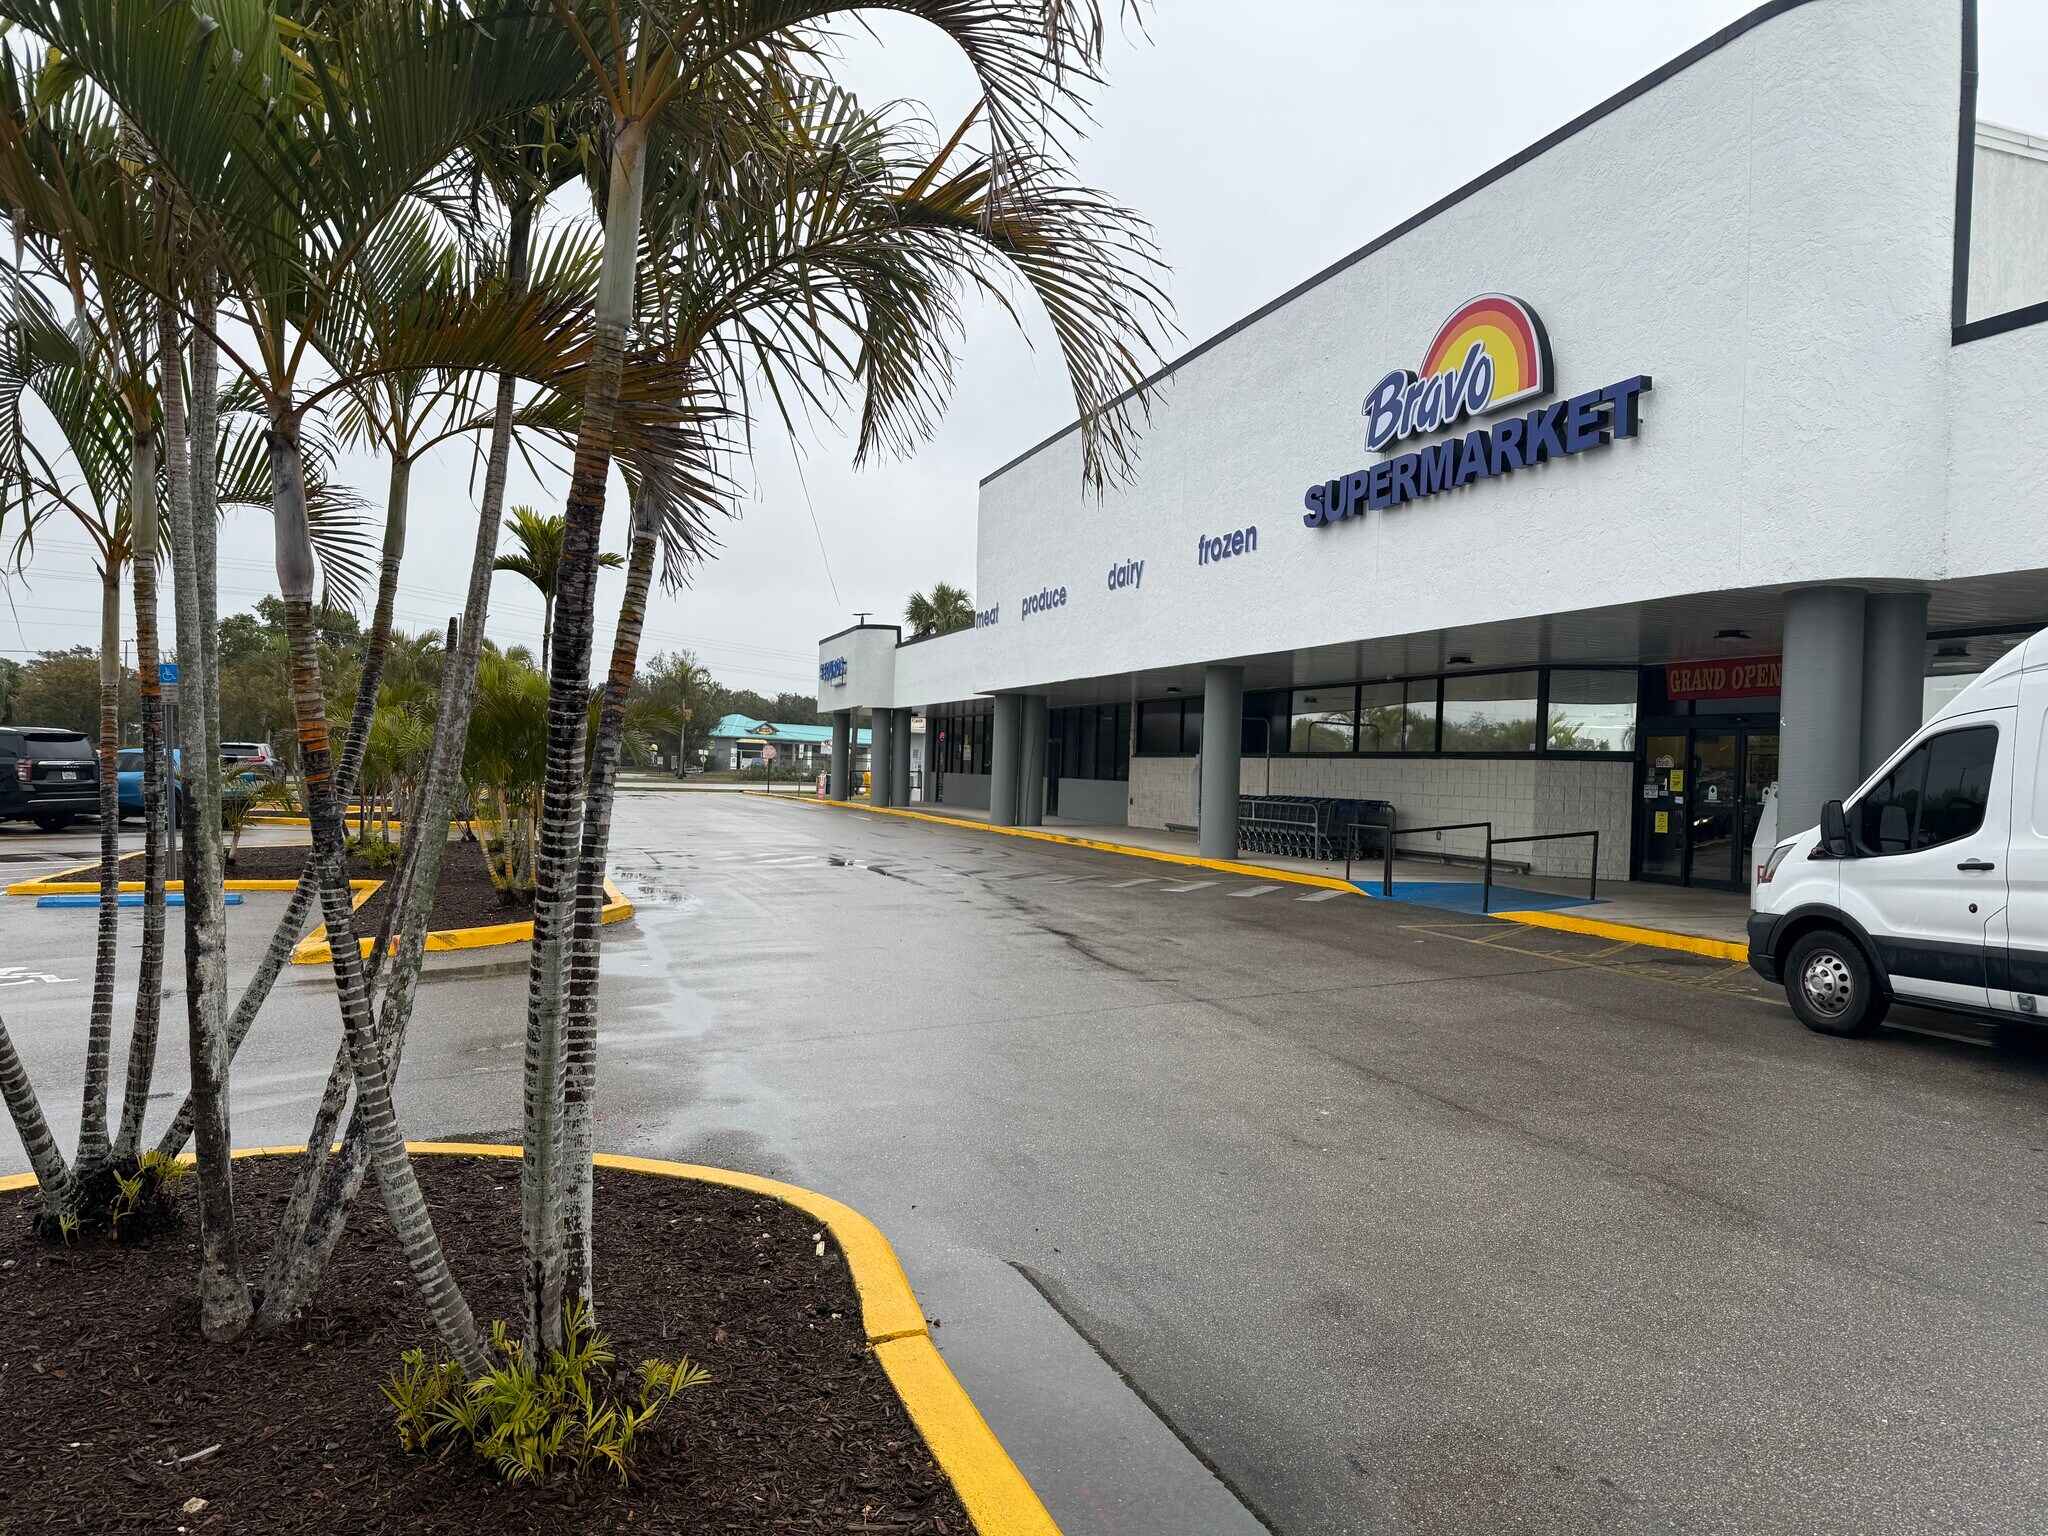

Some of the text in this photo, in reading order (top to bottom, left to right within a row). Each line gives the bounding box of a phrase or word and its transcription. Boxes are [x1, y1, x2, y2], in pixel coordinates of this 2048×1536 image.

[1362, 338, 1495, 452] Bravo
[1303, 375, 1652, 528] SUPERMARKET
[1198, 525, 1257, 566] frozen
[1107, 558, 1145, 591] dairy
[975, 602, 999, 629] meat
[1021, 586, 1067, 621] produce
[1669, 662, 1782, 693] GRAND OPEN
